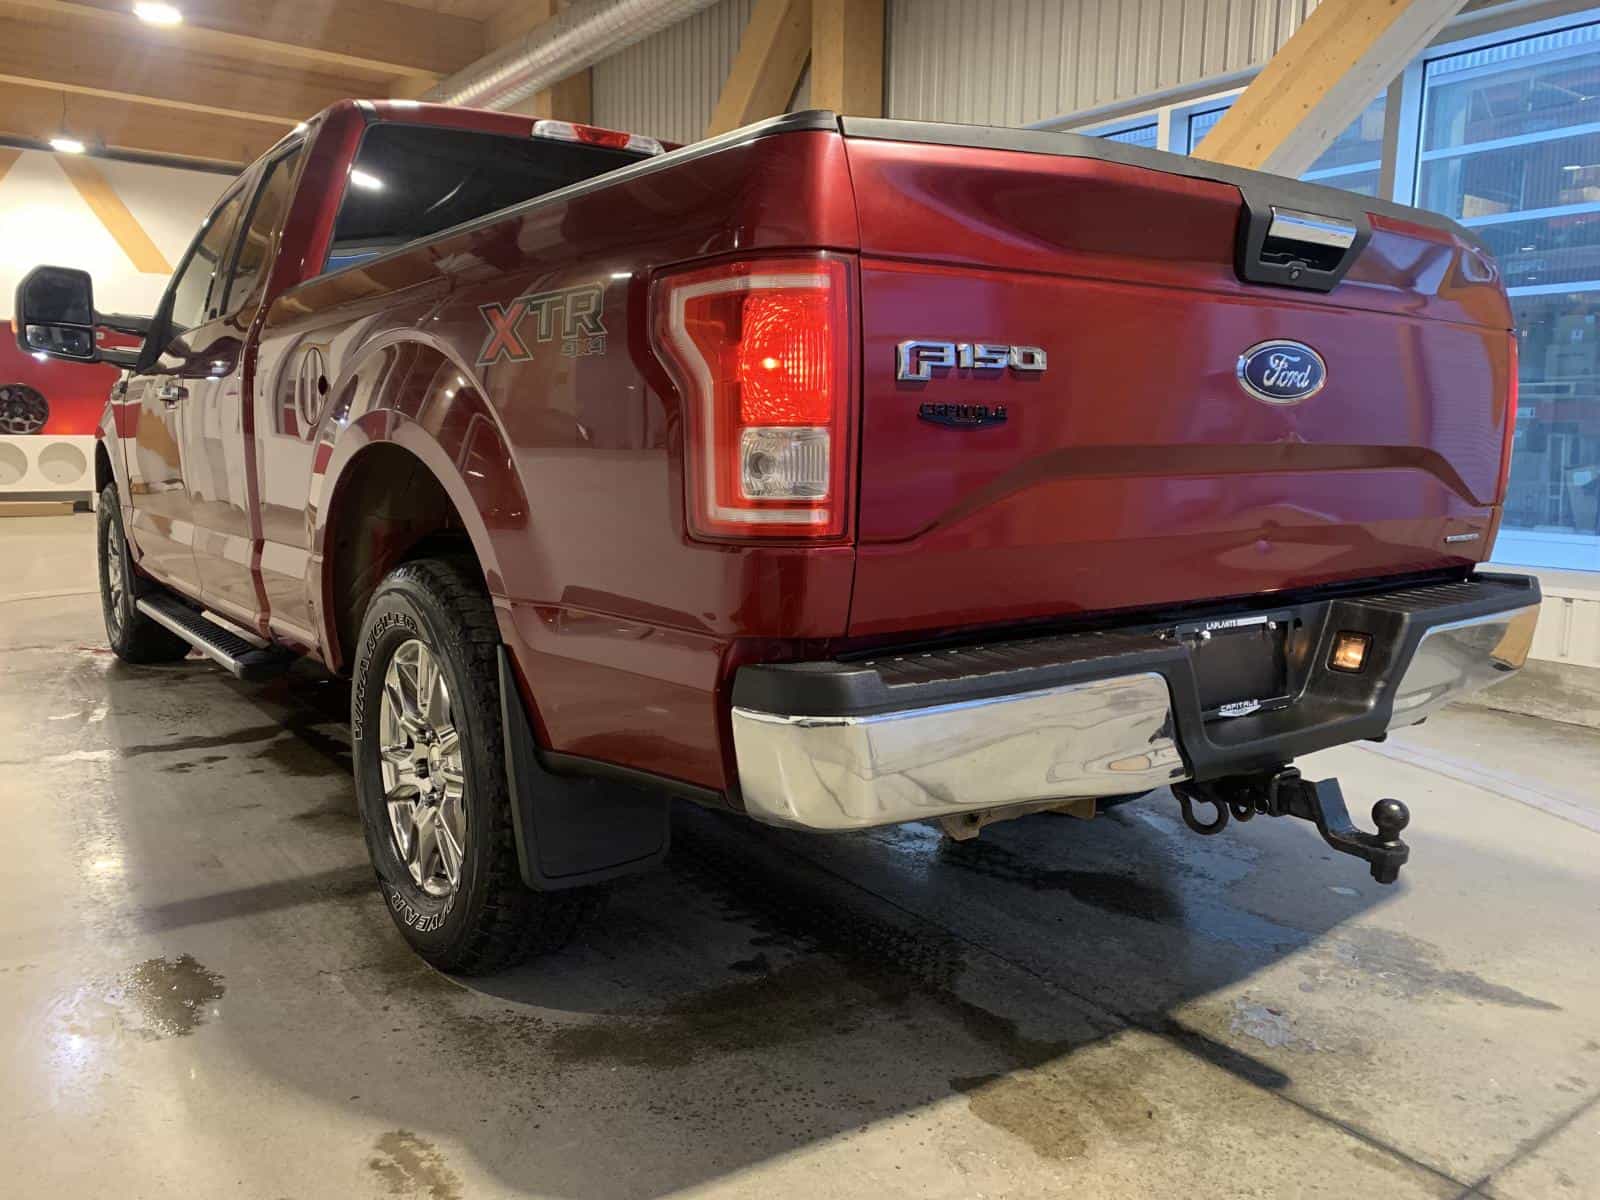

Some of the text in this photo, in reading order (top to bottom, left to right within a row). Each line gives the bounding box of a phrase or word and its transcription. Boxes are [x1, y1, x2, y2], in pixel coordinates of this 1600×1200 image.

[475, 281, 608, 367] XTR
[1263, 353, 1312, 388] Ford
[353, 611, 418, 741] WRANGLER
